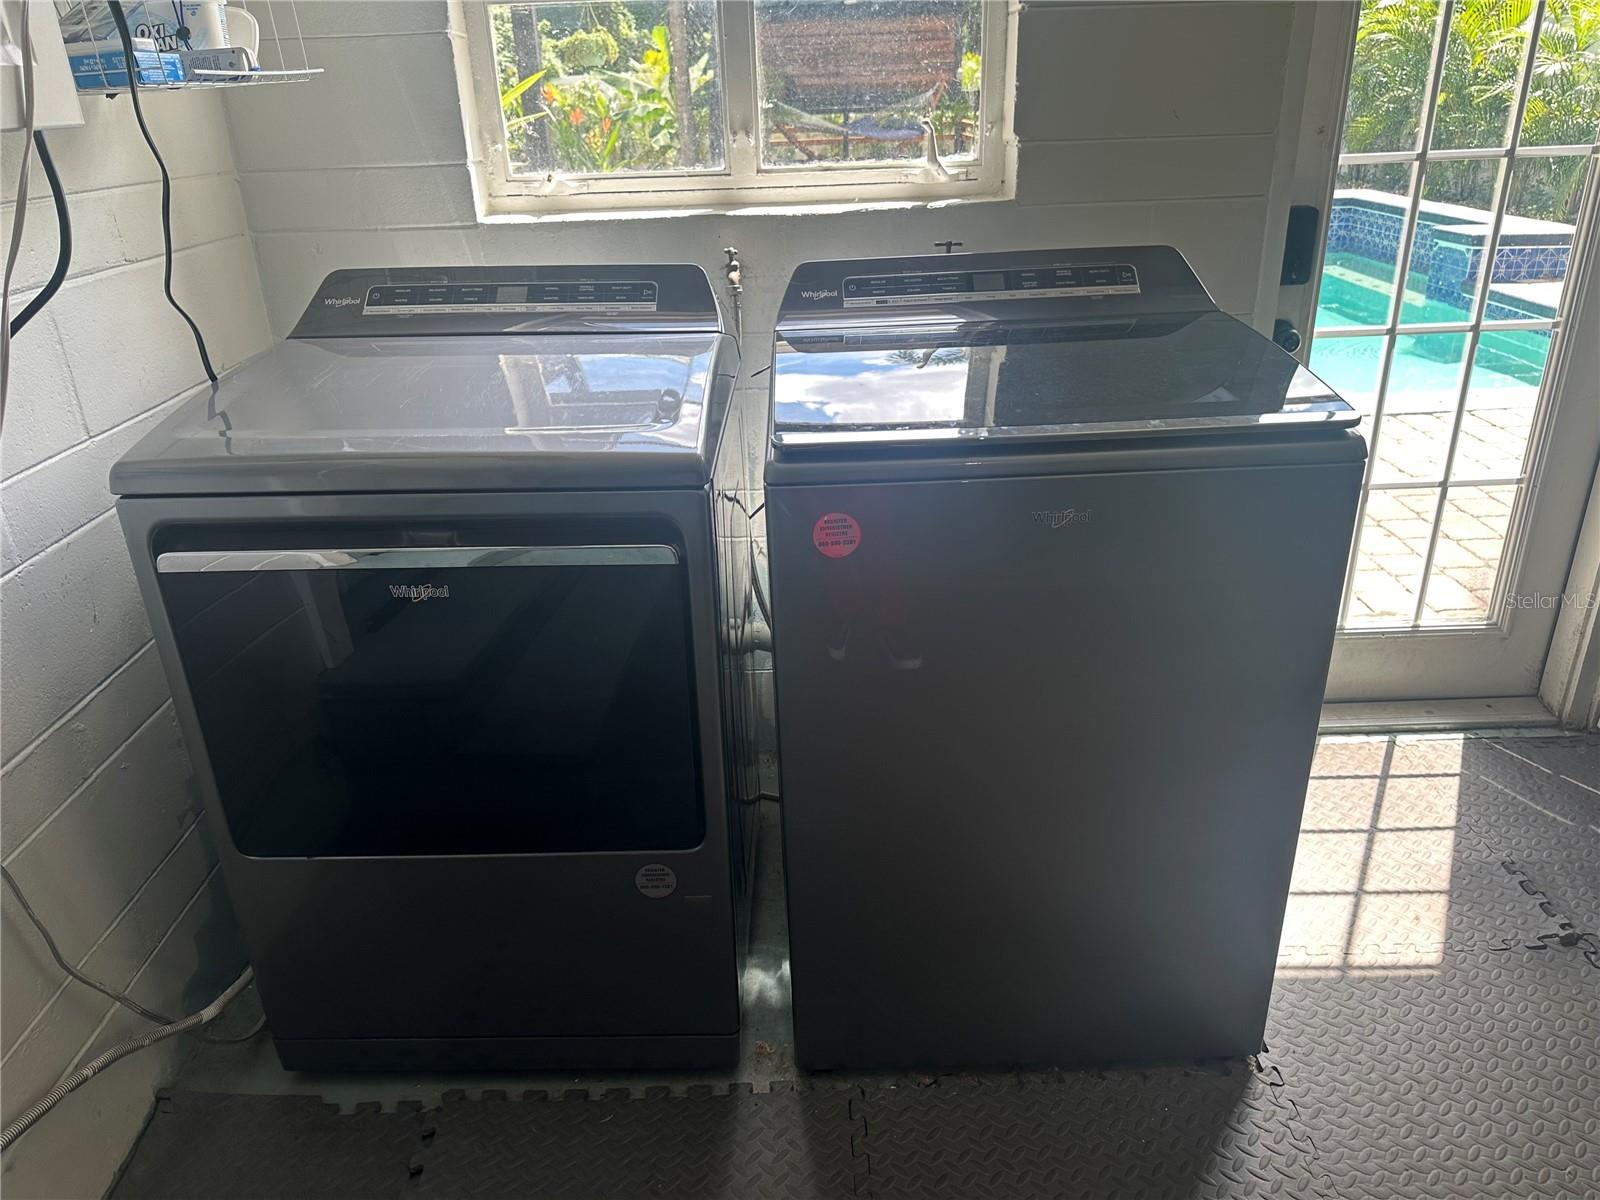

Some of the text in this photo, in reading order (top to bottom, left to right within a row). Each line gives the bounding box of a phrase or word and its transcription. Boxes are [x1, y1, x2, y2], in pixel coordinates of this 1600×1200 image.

[135, 23, 166, 39] OXI
[324, 296, 361, 308] Whirlpool
[801, 289, 838, 301] Whirlpool
[1032, 508, 1092, 528] Whirlpool
[389, 583, 450, 603] Whirlpool
